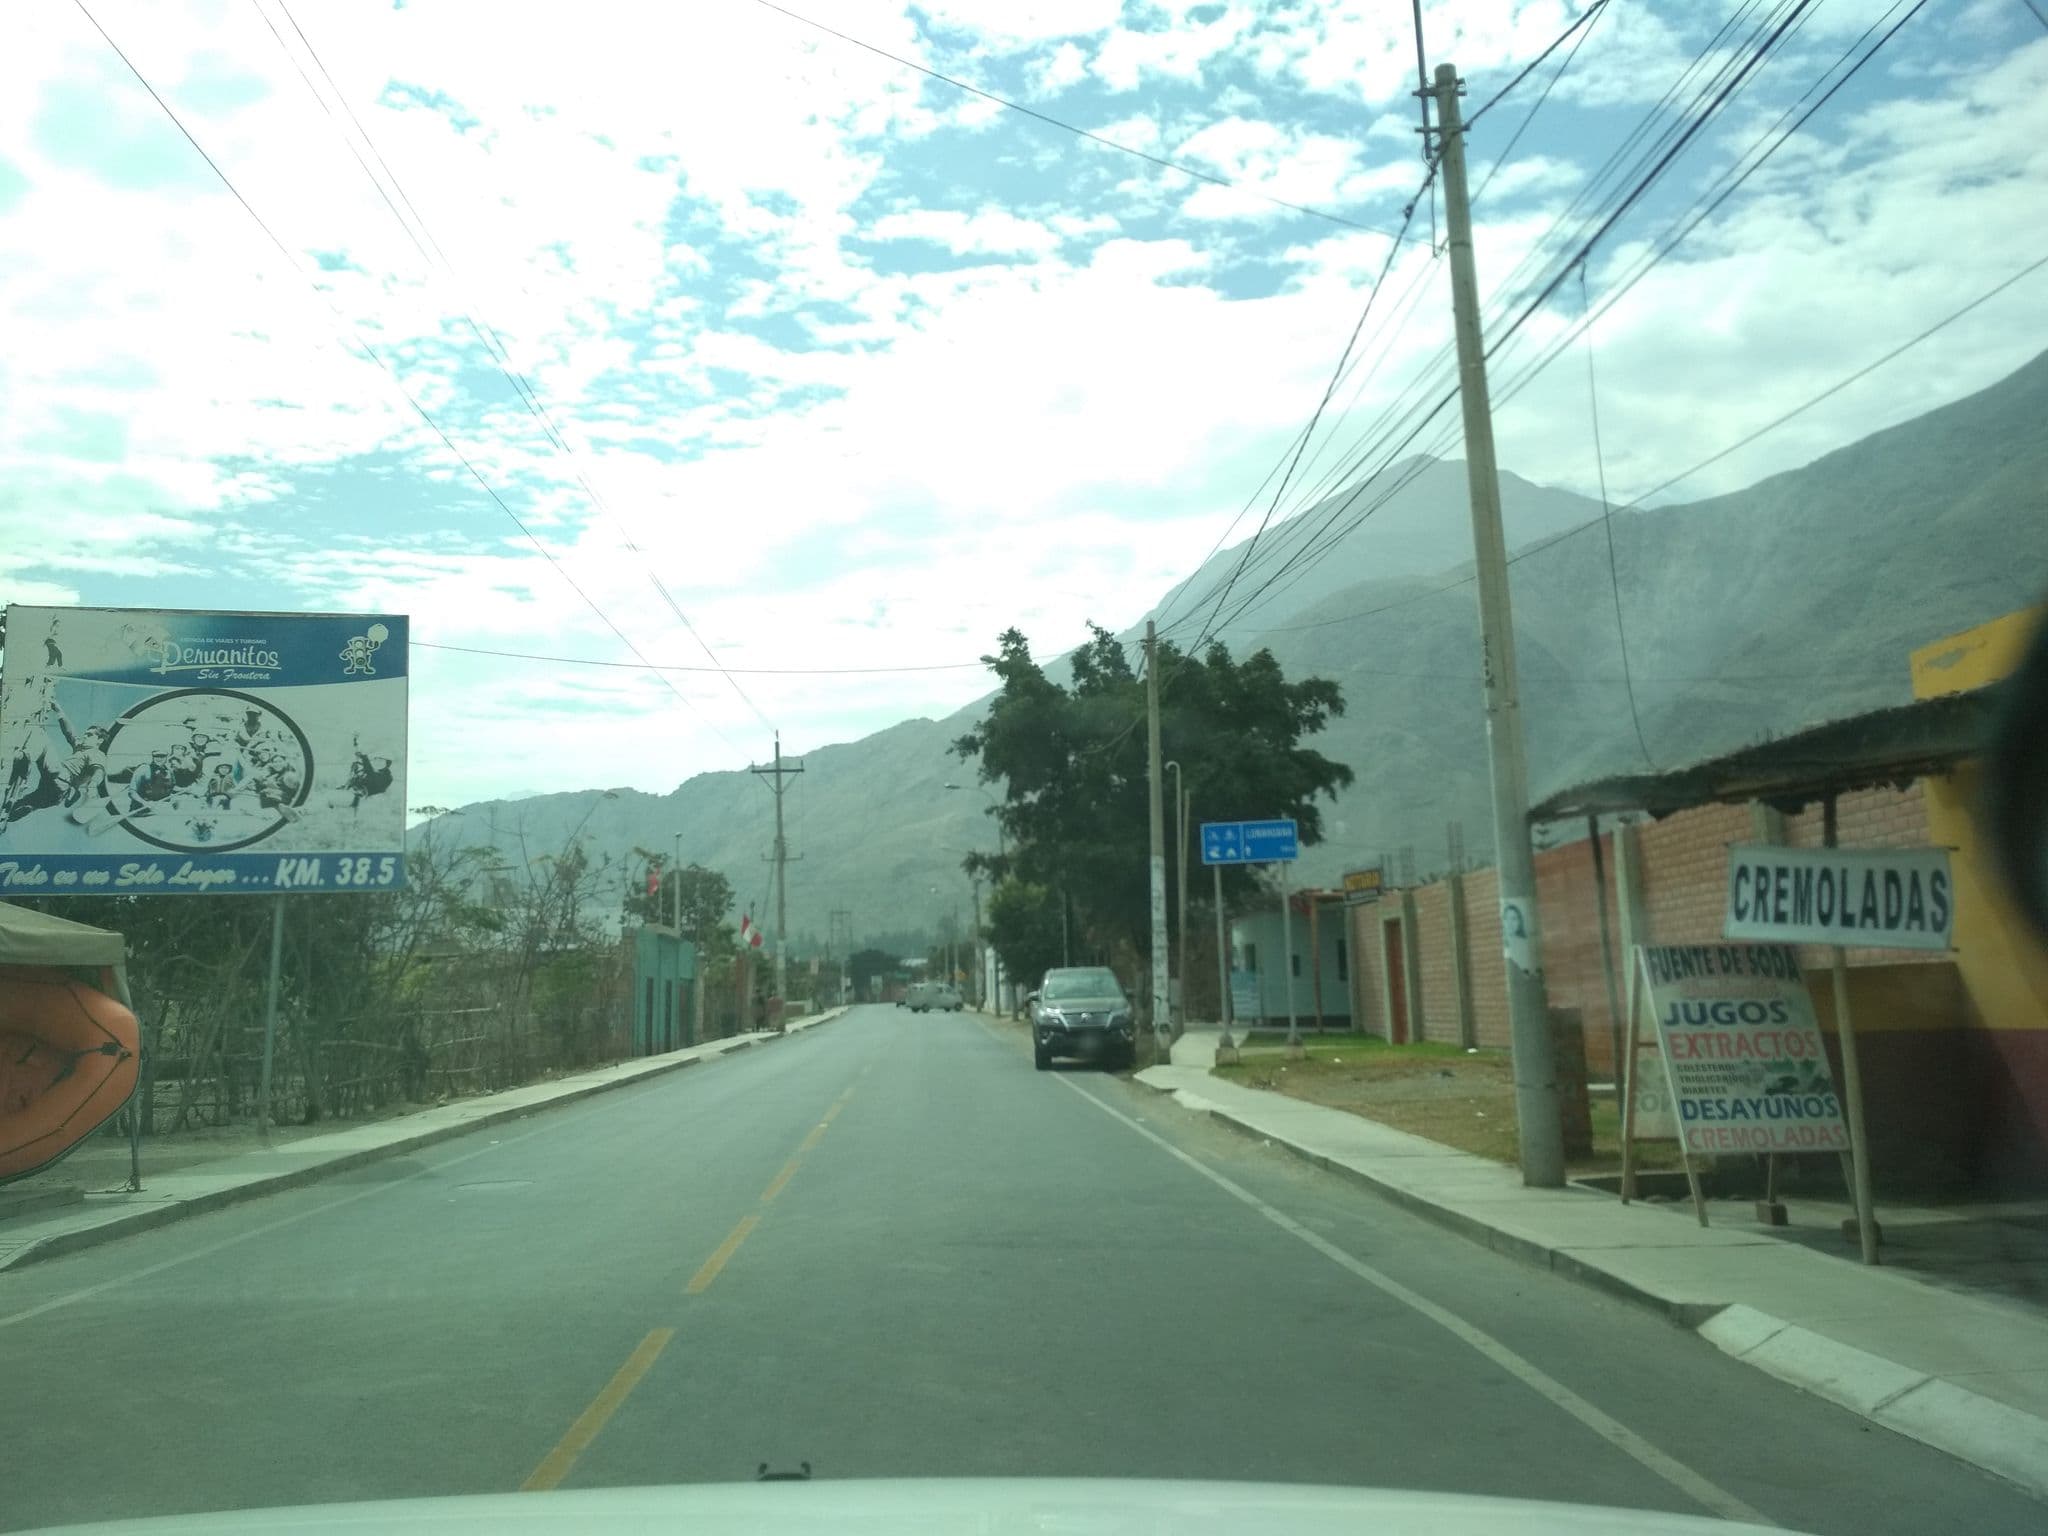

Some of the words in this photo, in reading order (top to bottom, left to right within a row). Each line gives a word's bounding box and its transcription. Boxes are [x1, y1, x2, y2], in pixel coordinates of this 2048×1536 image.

[197, 668, 220, 680] Sin
[223, 668, 271, 680] Frontera
[114, 862, 165, 886] Solo
[274, 858, 325, 888] KM.
[335, 856, 396, 885] 38.5
[1734, 864, 1950, 934] CREMOLADAS
[1647, 946, 1715, 985] FUENTE
[1717, 946, 1744, 976] DE
[1747, 945, 1801, 982] SODA
[1664, 1001, 1789, 1026] JUGOS
[1669, 1031, 1820, 1060] EXTRACTOS
[1681, 1095, 1839, 1121] DESAYUNOS
[1687, 1126, 1849, 1150] CREMOLADAS
